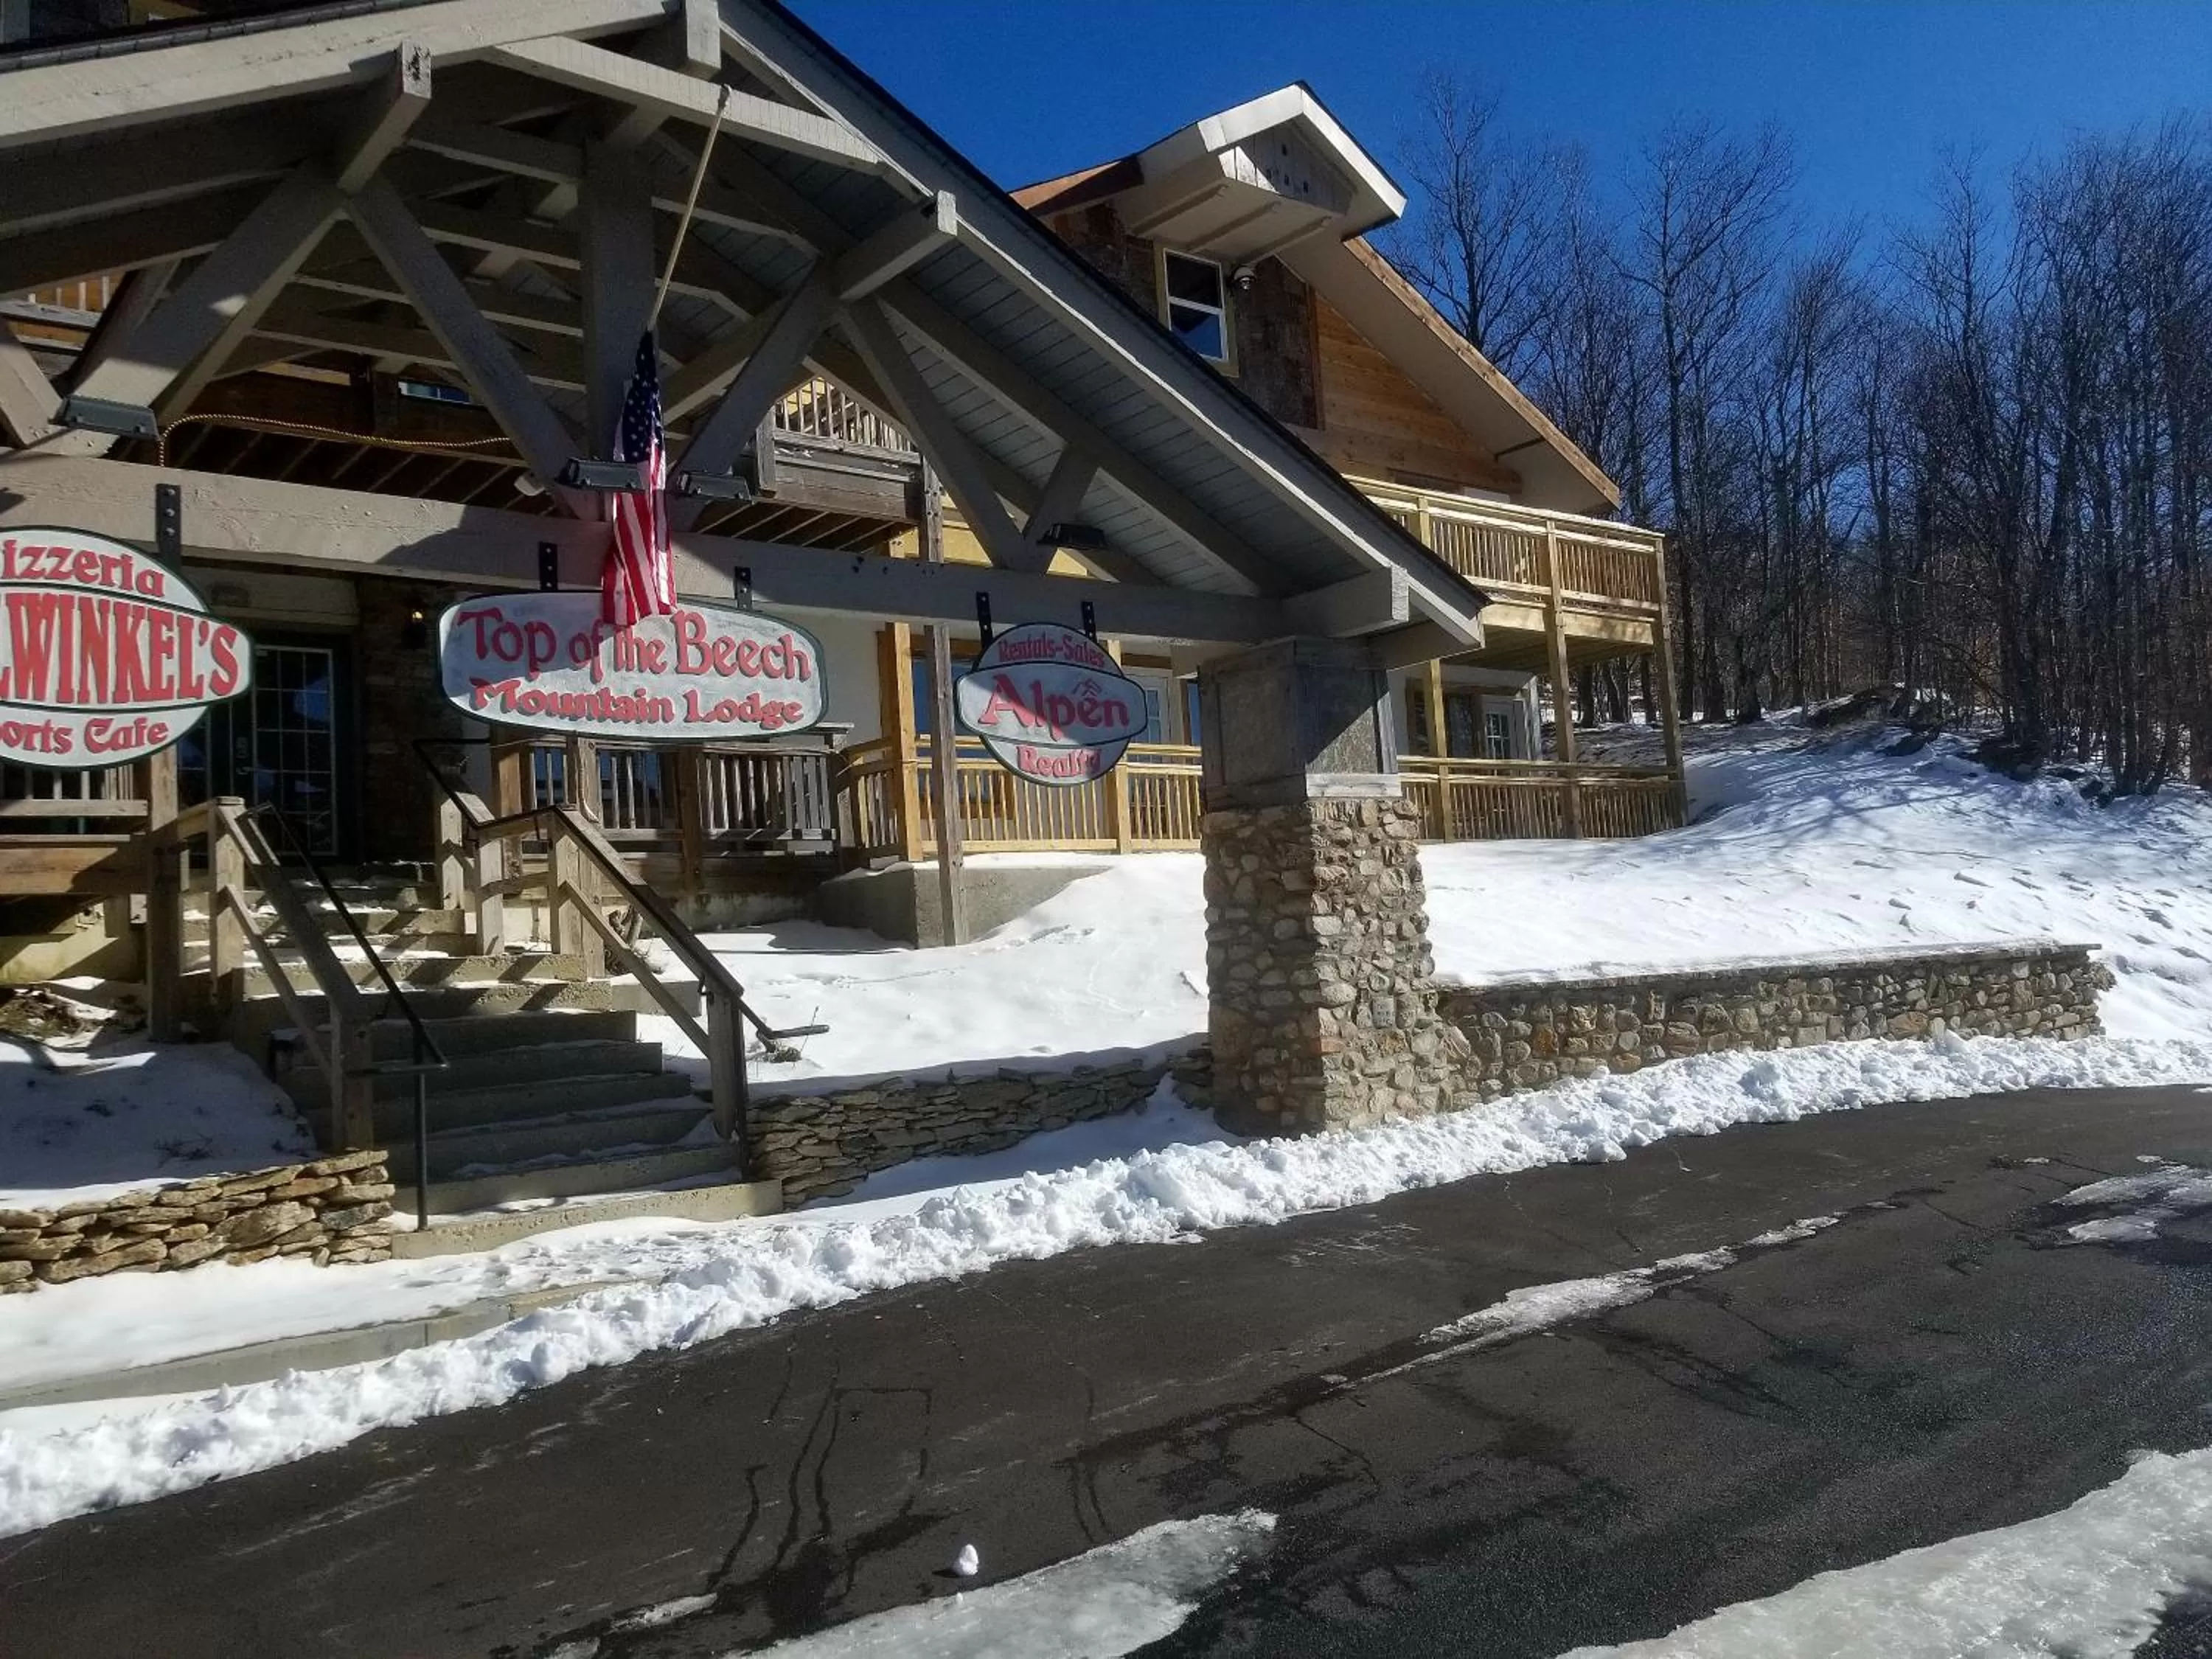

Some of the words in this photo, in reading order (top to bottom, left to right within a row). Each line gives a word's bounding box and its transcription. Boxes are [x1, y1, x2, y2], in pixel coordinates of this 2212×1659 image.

[0, 592, 238, 704] WINKEL'S
[456, 607, 557, 681] Top
[568, 616, 605, 685] of
[613, 625, 667, 675] the
[669, 610, 812, 682] Beech
[83, 717, 170, 754] Cafe
[469, 678, 675, 723] Mountain
[682, 689, 805, 730] Lodge
